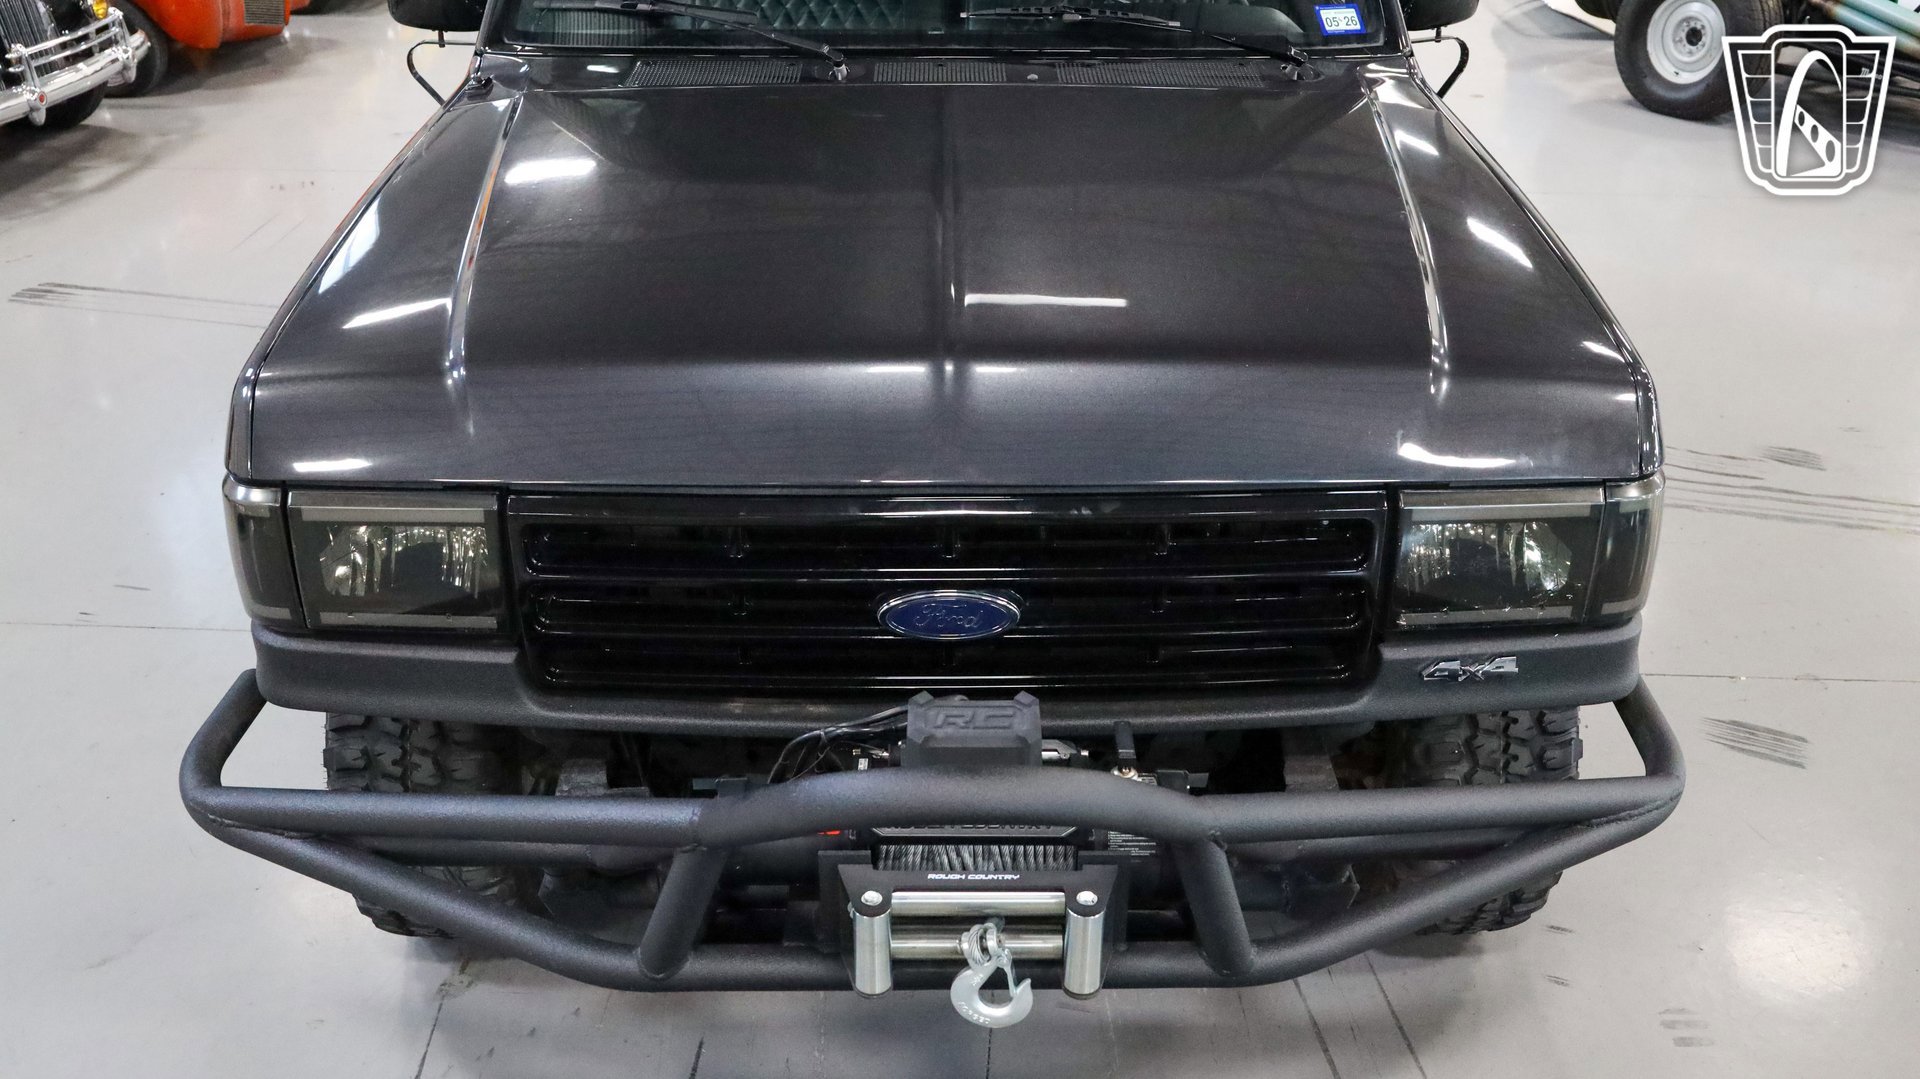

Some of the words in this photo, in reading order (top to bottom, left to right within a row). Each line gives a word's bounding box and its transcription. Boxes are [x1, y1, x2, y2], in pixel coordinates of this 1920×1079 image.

[1325, 16, 1340, 28] 05
[1343, 15, 1358, 27] 26
[914, 603, 984, 628] Ford
[933, 709, 1017, 730] RC
